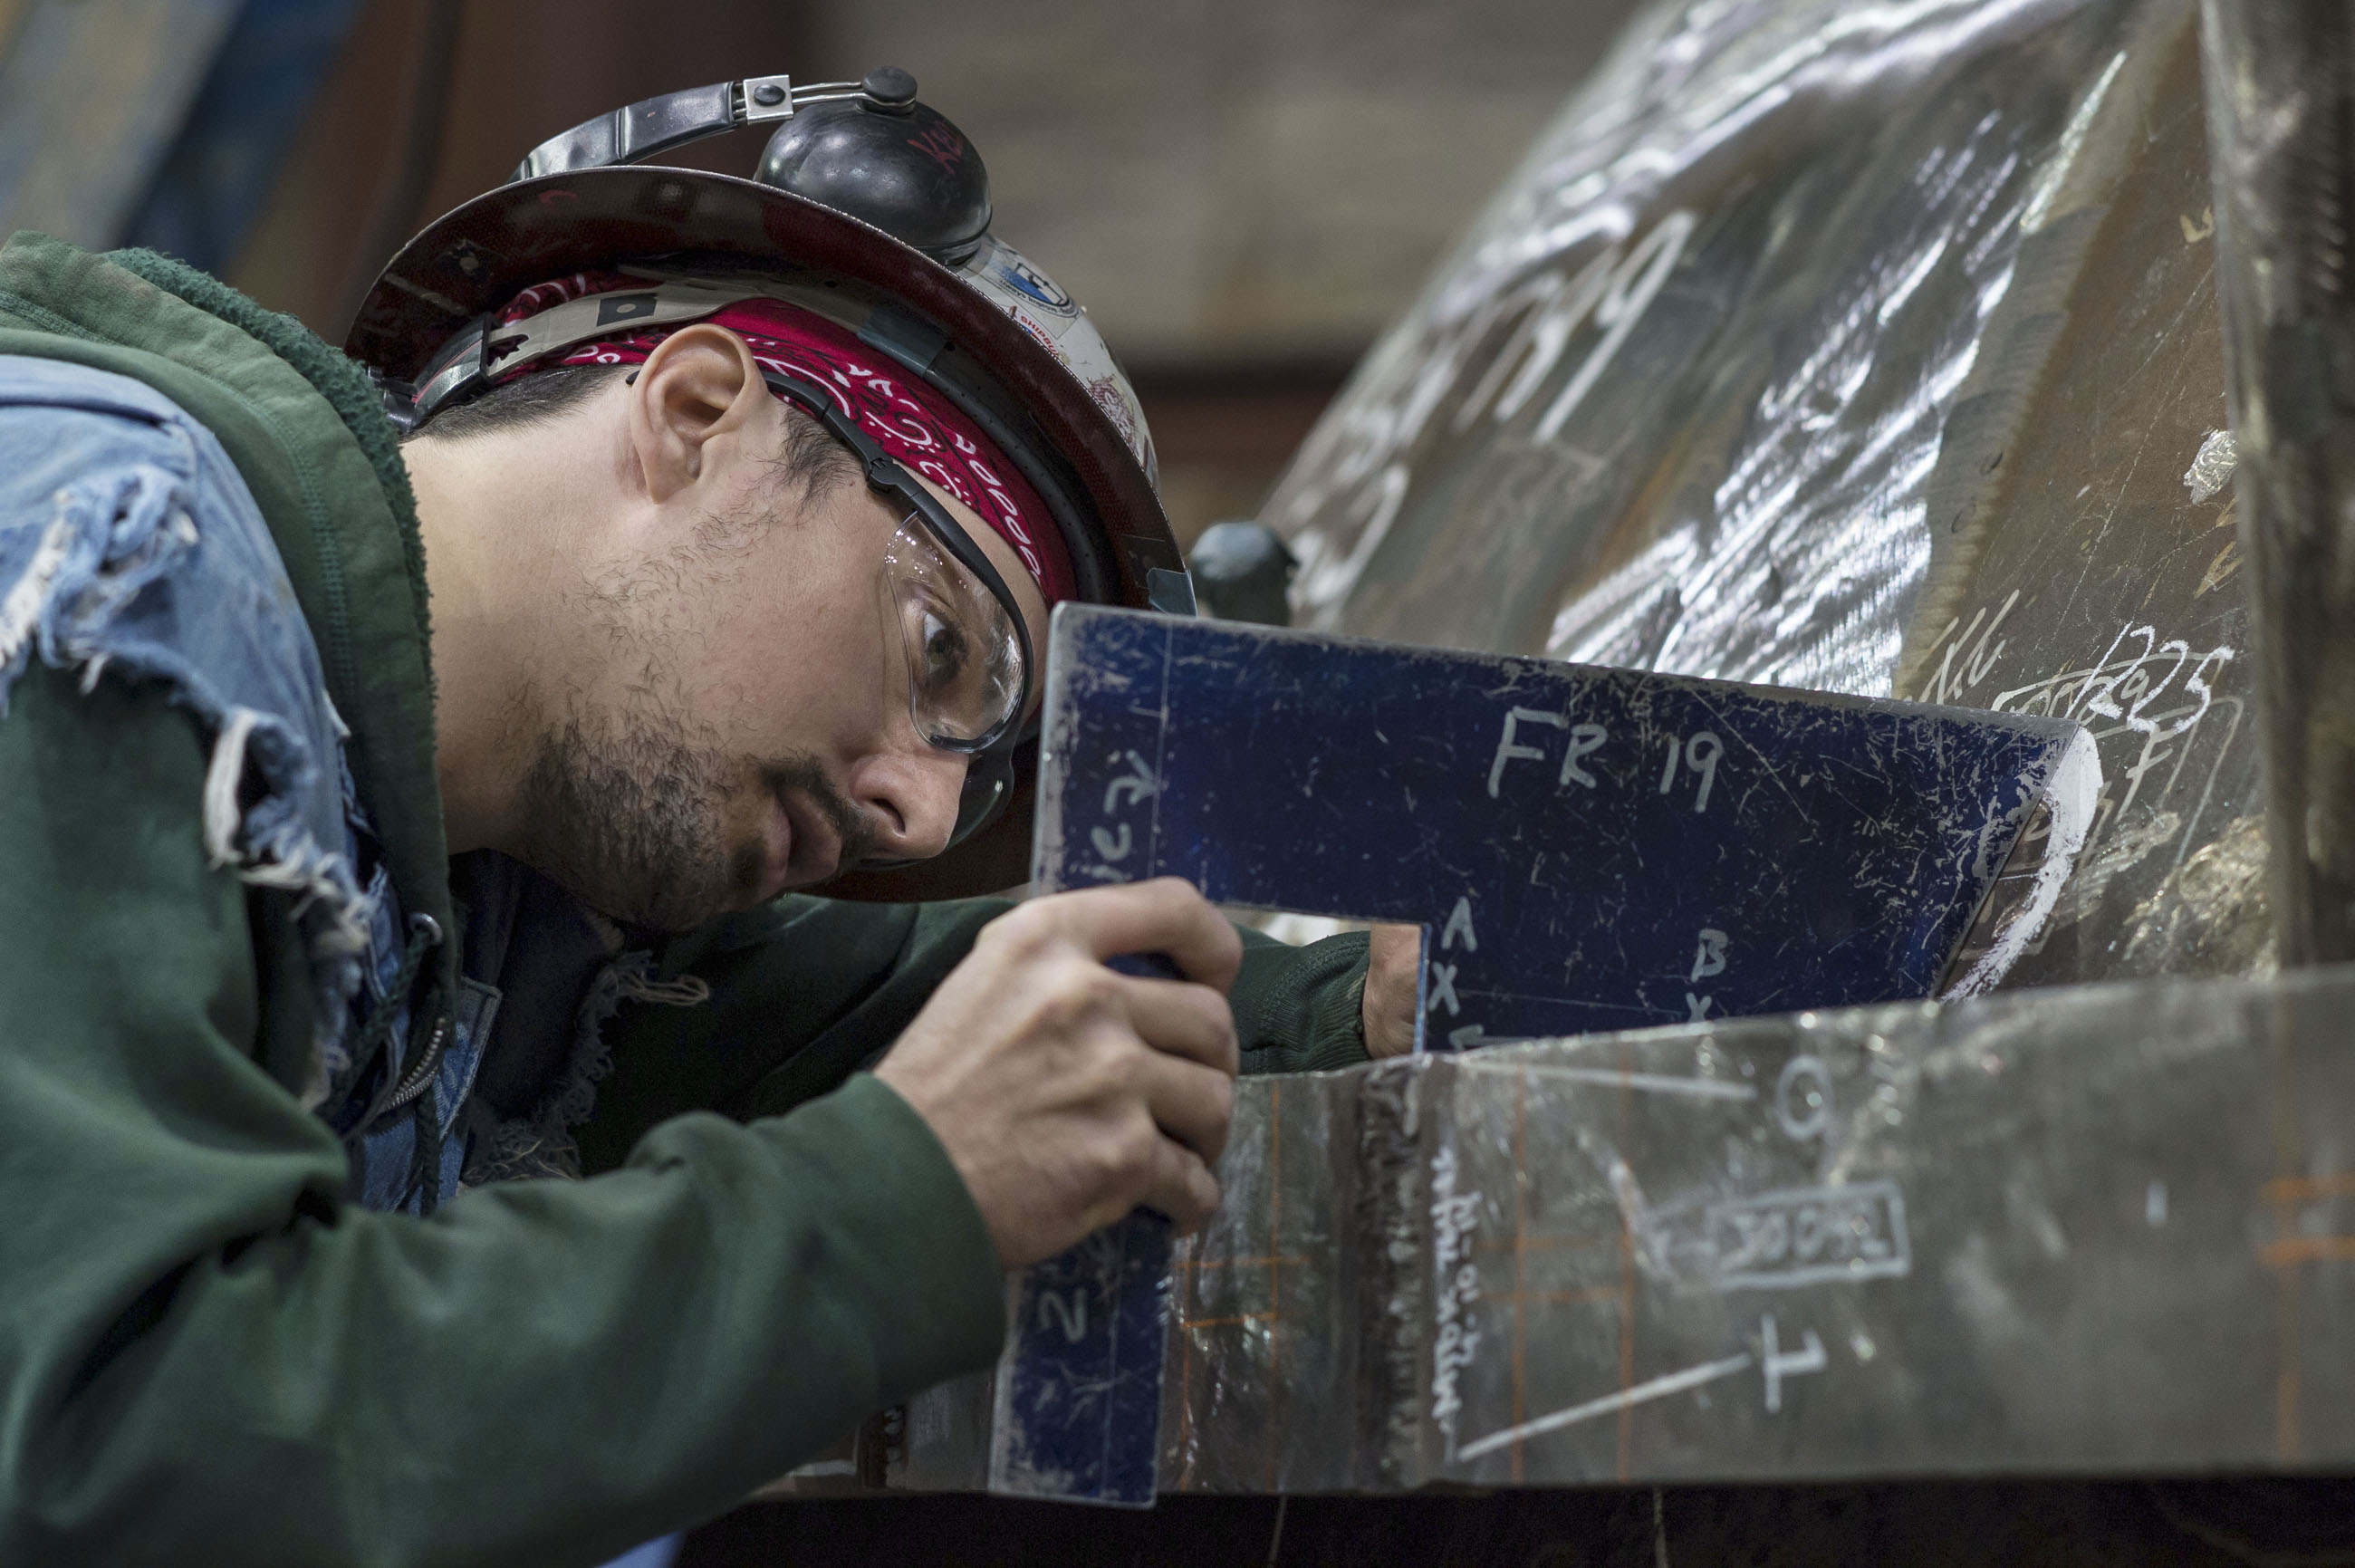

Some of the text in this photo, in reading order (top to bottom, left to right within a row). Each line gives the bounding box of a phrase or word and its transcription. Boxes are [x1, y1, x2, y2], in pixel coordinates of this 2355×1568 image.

[1487, 706, 1723, 813] FR 19
[1692, 928, 1730, 983] B
